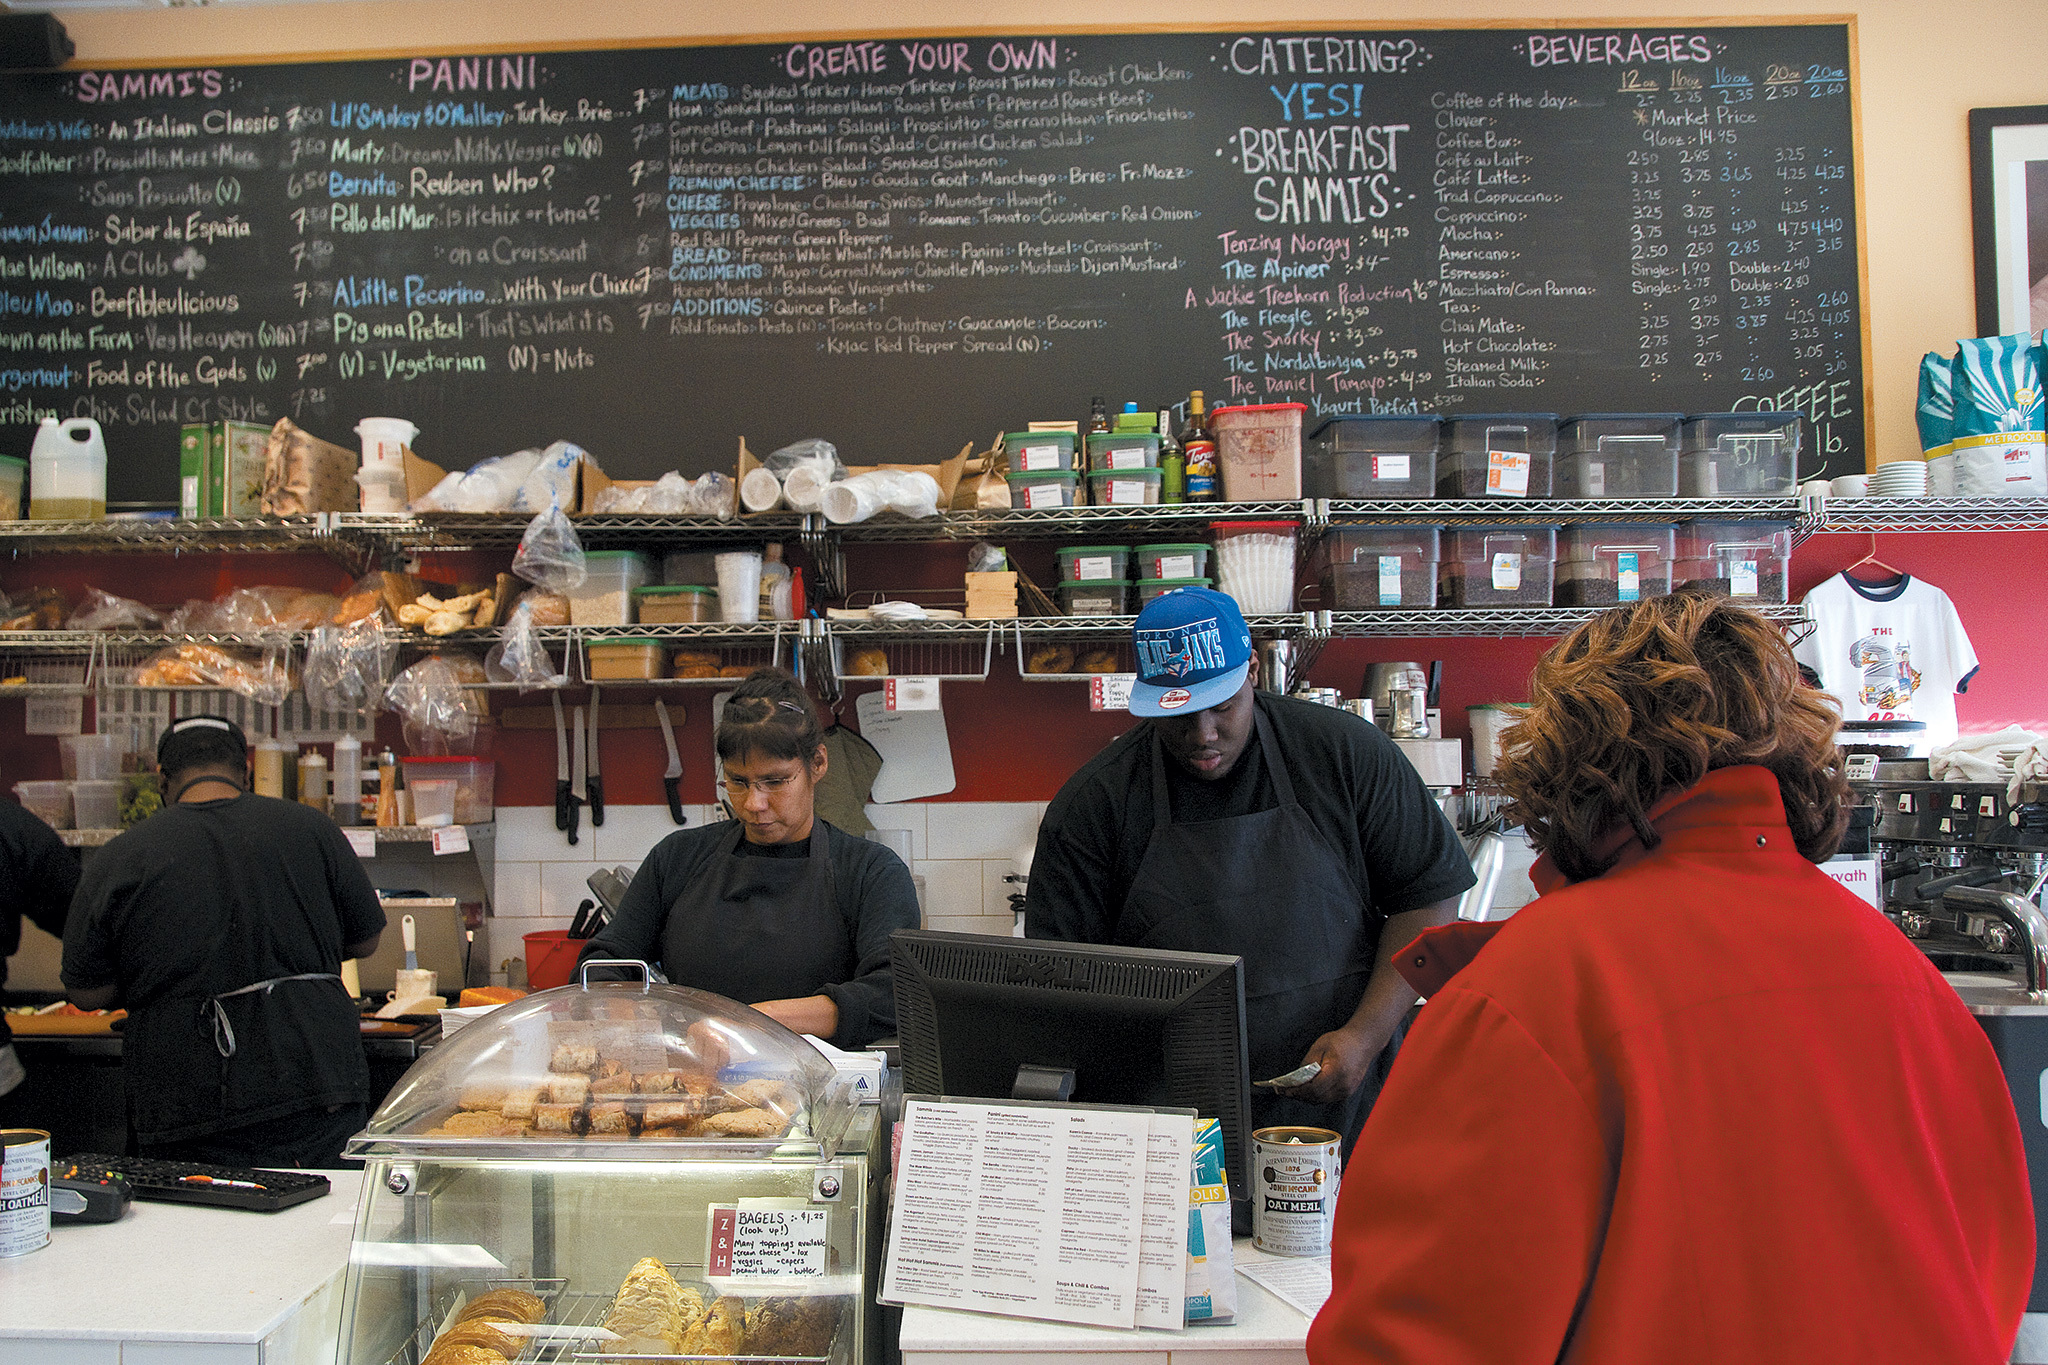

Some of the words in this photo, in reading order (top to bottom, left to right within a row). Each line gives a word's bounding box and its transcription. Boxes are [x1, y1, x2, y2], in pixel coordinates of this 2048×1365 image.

[786, 41, 887, 80] CREATE
[901, 42, 973, 74] YOUR
[987, 38, 1057, 72] OWN
[1230, 37, 1417, 75] CATERING?
[1528, 33, 1712, 68] BEVERAGES
[408, 56, 536, 92] PANINI
[77, 69, 222, 102] SAMMI'S
[1270, 81, 1364, 122] YES!
[1431, 91, 1483, 110] Coffee
[1488, 91, 1504, 109] of
[1509, 92, 1533, 108] the
[109, 120, 127, 140] An
[133, 114, 198, 141] Italian
[203, 107, 279, 134] Classic
[1435, 110, 1487, 130] Clover
[1716, 106, 1757, 124] Price
[1239, 124, 1410, 175] BREAKFAST
[1436, 131, 1483, 149] Coffee
[410, 166, 483, 199] Reuben
[1254, 173, 1389, 225] SAMMI'S
[1039, 207, 1110, 226] Cucumber
[1121, 205, 1148, 221] Red
[1150, 207, 1194, 221] Onion
[1438, 225, 1493, 243] Mocha
[1217, 230, 1281, 263] Tenzing
[1291, 233, 1351, 262] Norgay
[1438, 244, 1509, 262] Americano
[1221, 259, 1256, 280] The
[1263, 258, 1331, 283] Alpiner
[1439, 263, 1500, 281] Espresso
[1185, 288, 1198, 309] A
[1205, 281, 1255, 307] Jackie
[1258, 284, 1330, 304] Treehorn
[1338, 282, 1413, 304] Production
[671, 298, 763, 317] ADDITIONS
[1438, 299, 1470, 315] Tea
[1221, 309, 1250, 330] The
[1221, 331, 1254, 351] The
[1263, 328, 1321, 359] Snorky
[1443, 338, 1473, 354] Hot
[1477, 337, 1548, 353] Chocolate
[88, 359, 130, 388] Food
[134, 360, 156, 389] of
[160, 363, 190, 389] the
[196, 356, 247, 388] Gods
[382, 350, 486, 381] Vegetarian
[554, 346, 594, 373] Nuts
[1223, 354, 1257, 373] The
[1445, 357, 1505, 372] Steamed
[1510, 356, 1540, 370] Milk
[1223, 375, 1257, 397] The
[1265, 373, 1315, 394] Daniel
[1326, 371, 1386, 398] Tamayo
[1446, 375, 1496, 388] Italian
[1499, 373, 1534, 388] Soda
[1311, 393, 1362, 417] Yogurt
[1371, 398, 1418, 415] Parfait
[1984, 432, 2042, 445] METROPOLIS
[1137, 620, 1217, 640] TORONTO
[1181, 628, 1226, 671] JAYS
[1267, 1199, 1288, 1210] OAT
[1290, 1201, 1321, 1211] MEAL
[721, 1219, 729, 1230] Z
[738, 1212, 785, 1224] BAGELS
[718, 1238, 727, 1248] &
[734, 1240, 755, 1249] Many
[759, 1240, 794, 1251] toppings
[717, 1256, 726, 1267] H
